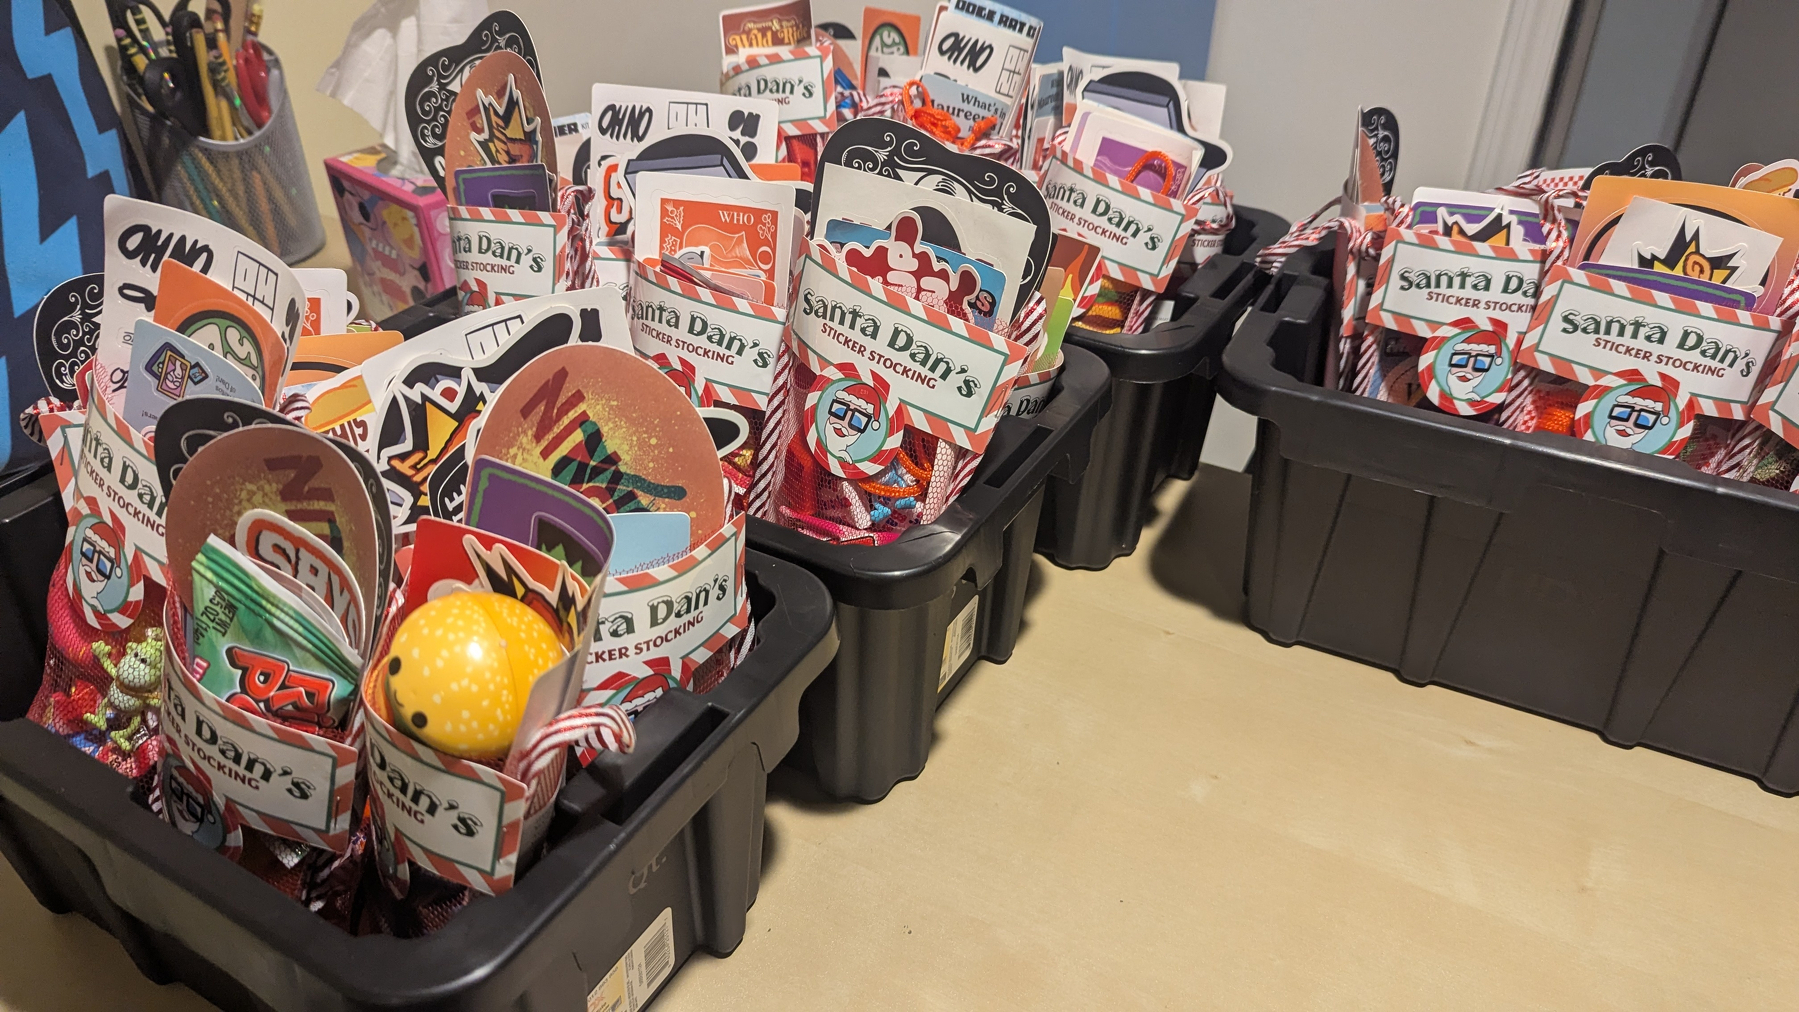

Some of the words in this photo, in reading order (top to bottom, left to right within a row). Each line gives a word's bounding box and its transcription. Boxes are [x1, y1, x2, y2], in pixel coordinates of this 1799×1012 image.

[729, 29, 772, 48] Wild
[778, 24, 807, 45] Ride
[756, 74, 816, 99] Dan's
[961, 92, 999, 115] What's
[718, 210, 754, 226] WHO
[1044, 180, 1088, 210] Santa
[1091, 194, 1163, 251] Dan's
[1049, 201, 1076, 223] STICKER
[1076, 217, 1130, 246] STOCKING
[470, 261, 515, 275] STOCKING
[477, 231, 546, 273] Dan's
[1397, 266, 1493, 292] Santa
[1500, 270, 1540, 299] Da
[1426, 291, 1481, 309] STICKER
[1483, 300, 1537, 314] STOCKIN
[631, 296, 681, 330] Santa
[687, 311, 774, 369] Dan's
[641, 322, 673, 345] STICKER
[674, 338, 735, 366] STOCKING
[803, 287, 881, 341] Santa
[887, 322, 982, 399] Dan's
[1561, 309, 1669, 345] Santa
[1676, 325, 1756, 378] Dan's
[821, 323, 866, 358] STICKER
[867, 350, 938, 390] STOCKING
[1592, 337, 1653, 362] STICKER
[1654, 353, 1727, 378] STOCKING
[105, 484, 166, 538] STOCKING
[200, 605, 220, 624] OZ
[221, 598, 239, 623] NET
[647, 573, 729, 629] Dan's
[211, 617, 231, 638] WT
[634, 610, 704, 655] STOCKING
[183, 733, 260, 791] STOCKING
[194, 709, 316, 801] Dan's
